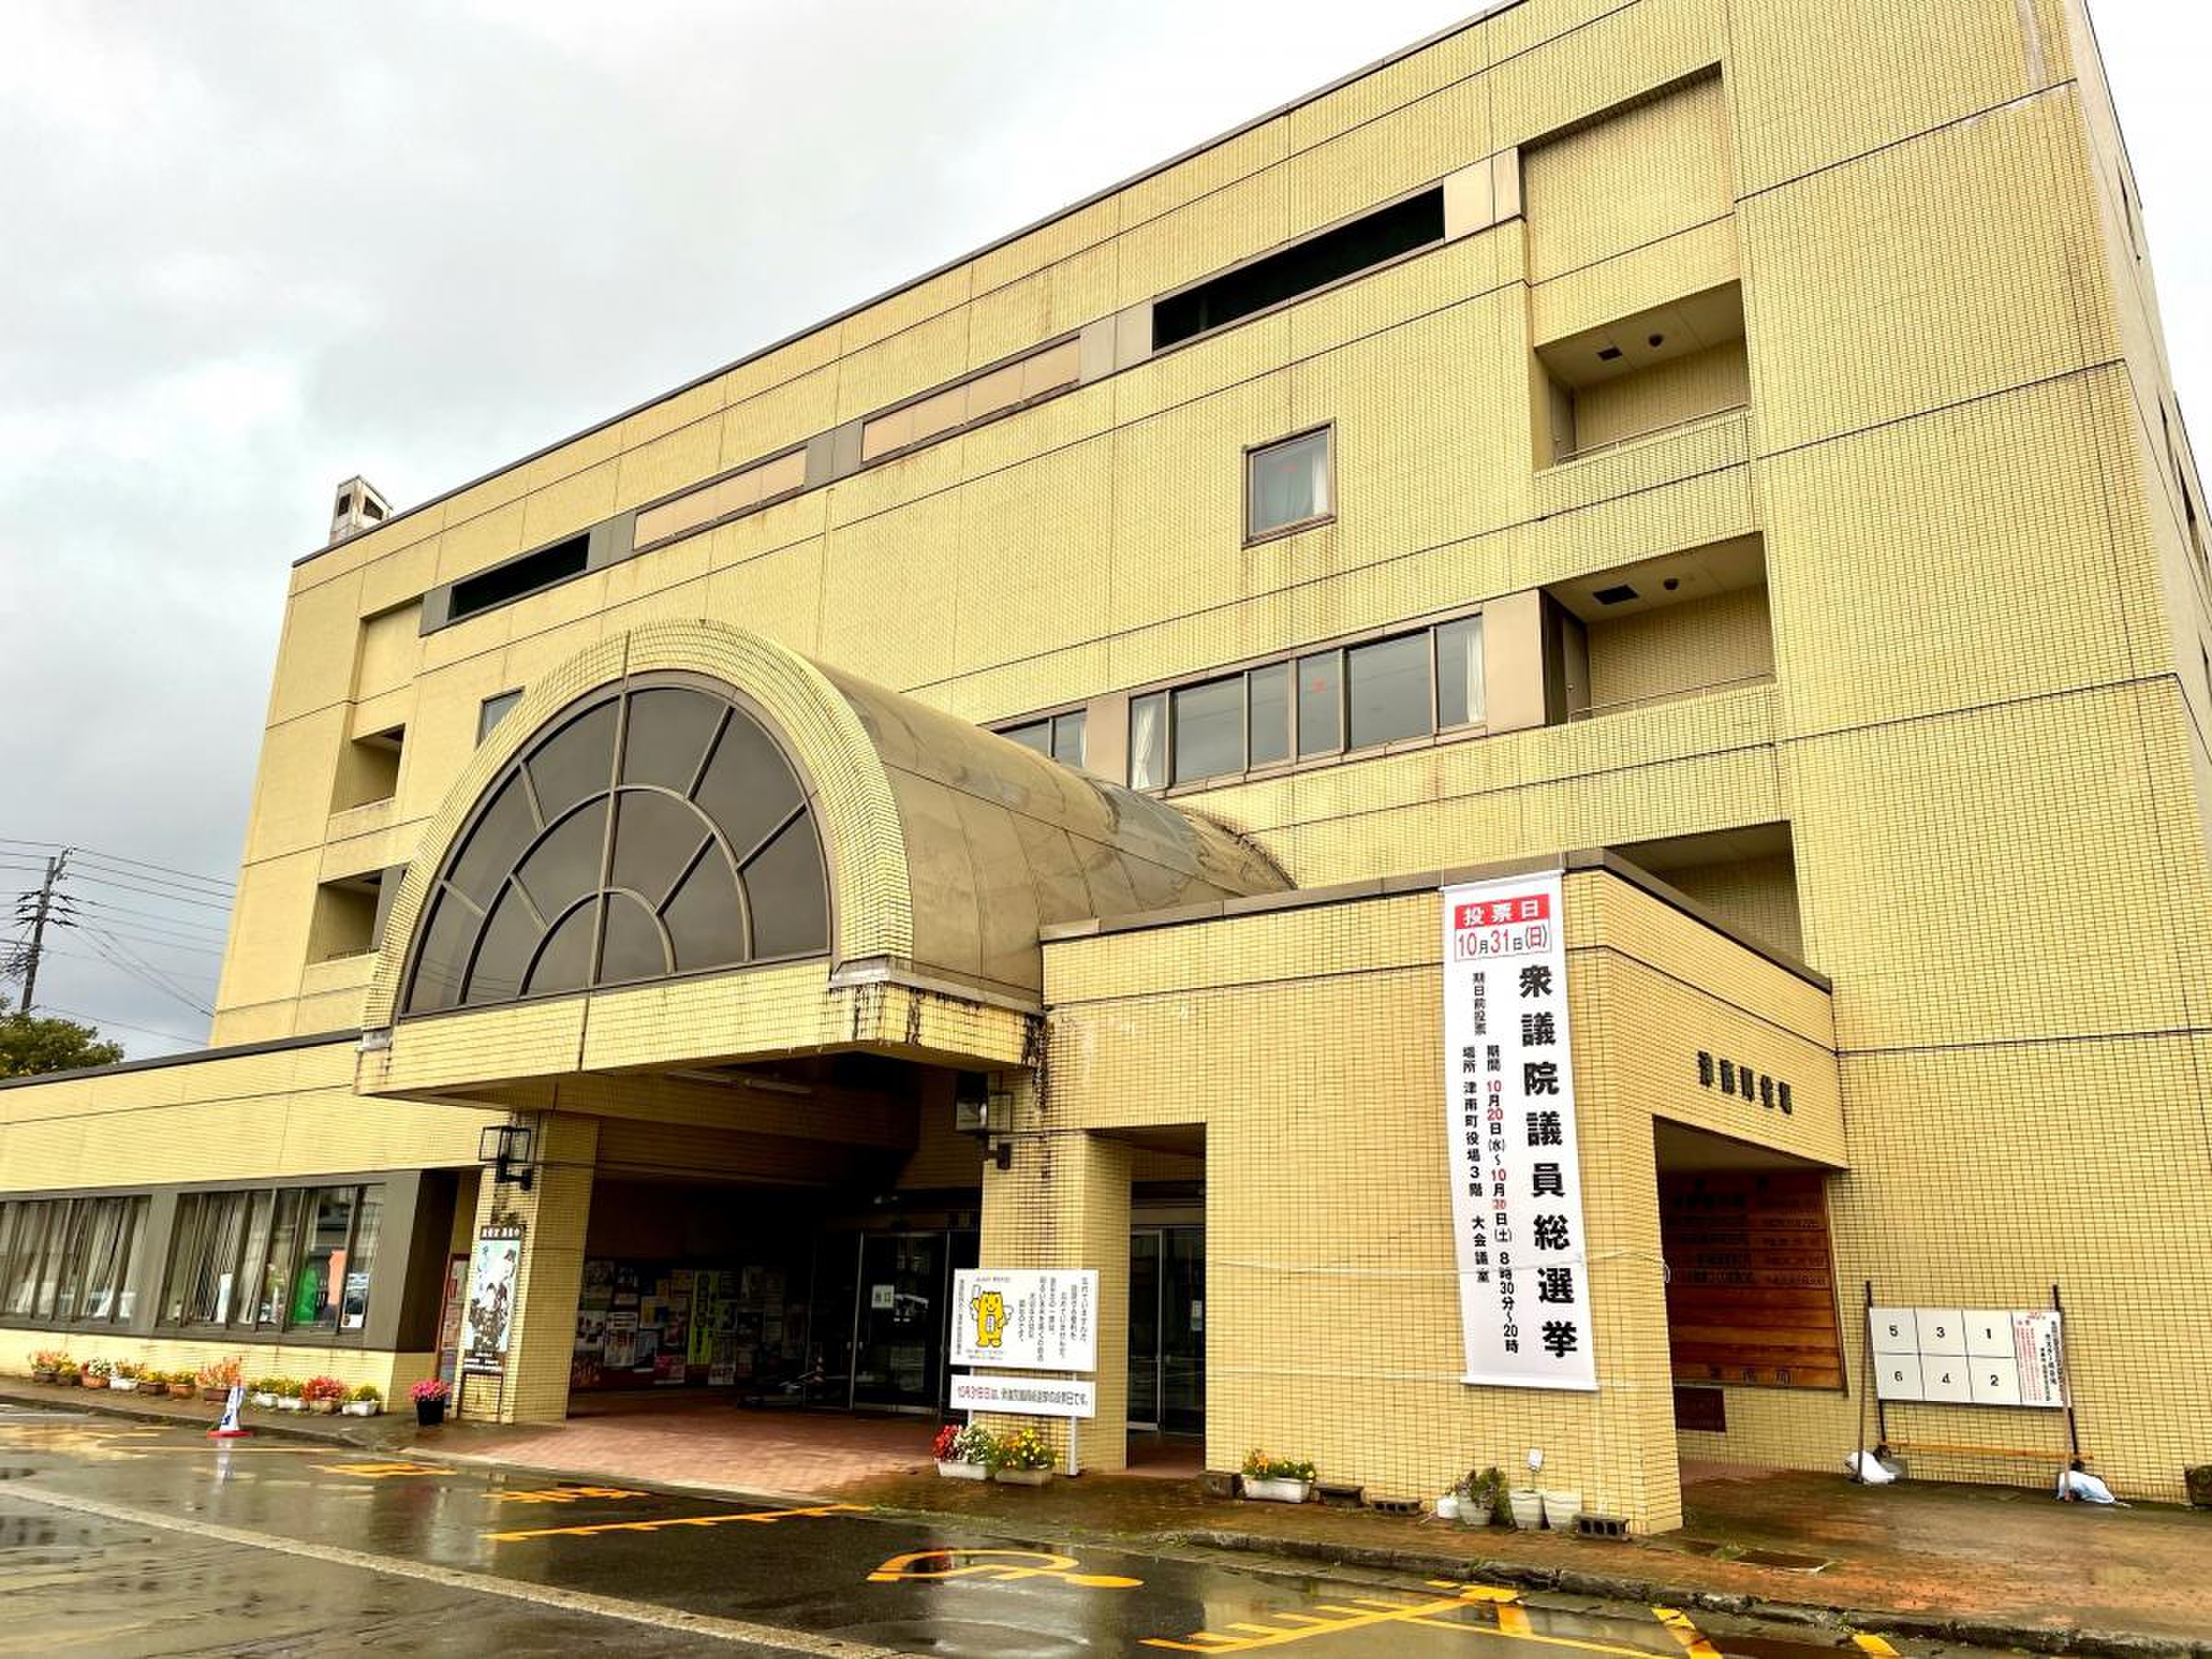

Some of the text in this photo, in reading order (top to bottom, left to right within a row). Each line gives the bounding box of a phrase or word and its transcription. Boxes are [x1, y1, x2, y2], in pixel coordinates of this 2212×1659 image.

[1463, 899, 1540, 927] 投票日
[1518, 963, 1578, 1359] 衆議院議員総選挙
[1888, 1324, 1993, 1340] 5 3 1
[1894, 1371, 1999, 1386] 6 4 2
